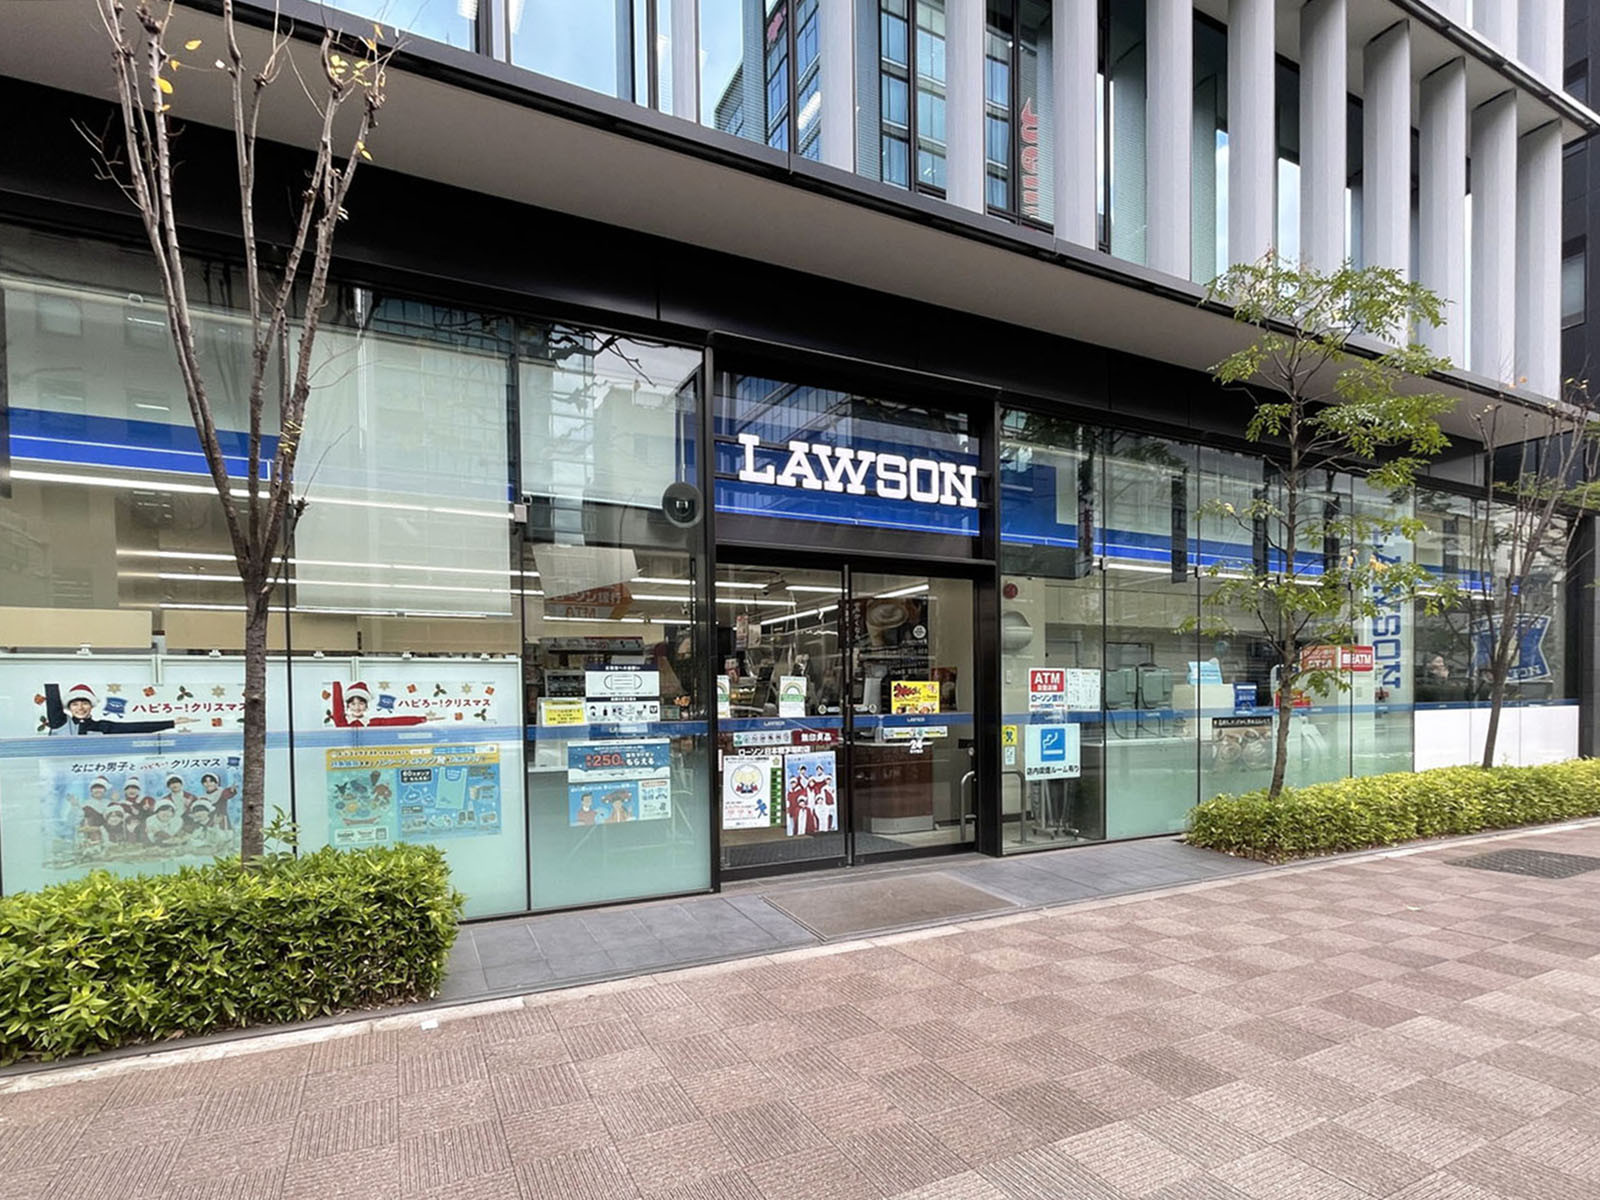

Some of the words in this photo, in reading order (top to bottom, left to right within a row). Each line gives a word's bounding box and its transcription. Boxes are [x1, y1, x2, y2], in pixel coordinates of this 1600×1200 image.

[738, 433, 977, 508] LAWSON
[1034, 672, 1060, 684] ATM
[593, 753, 620, 766] 250
